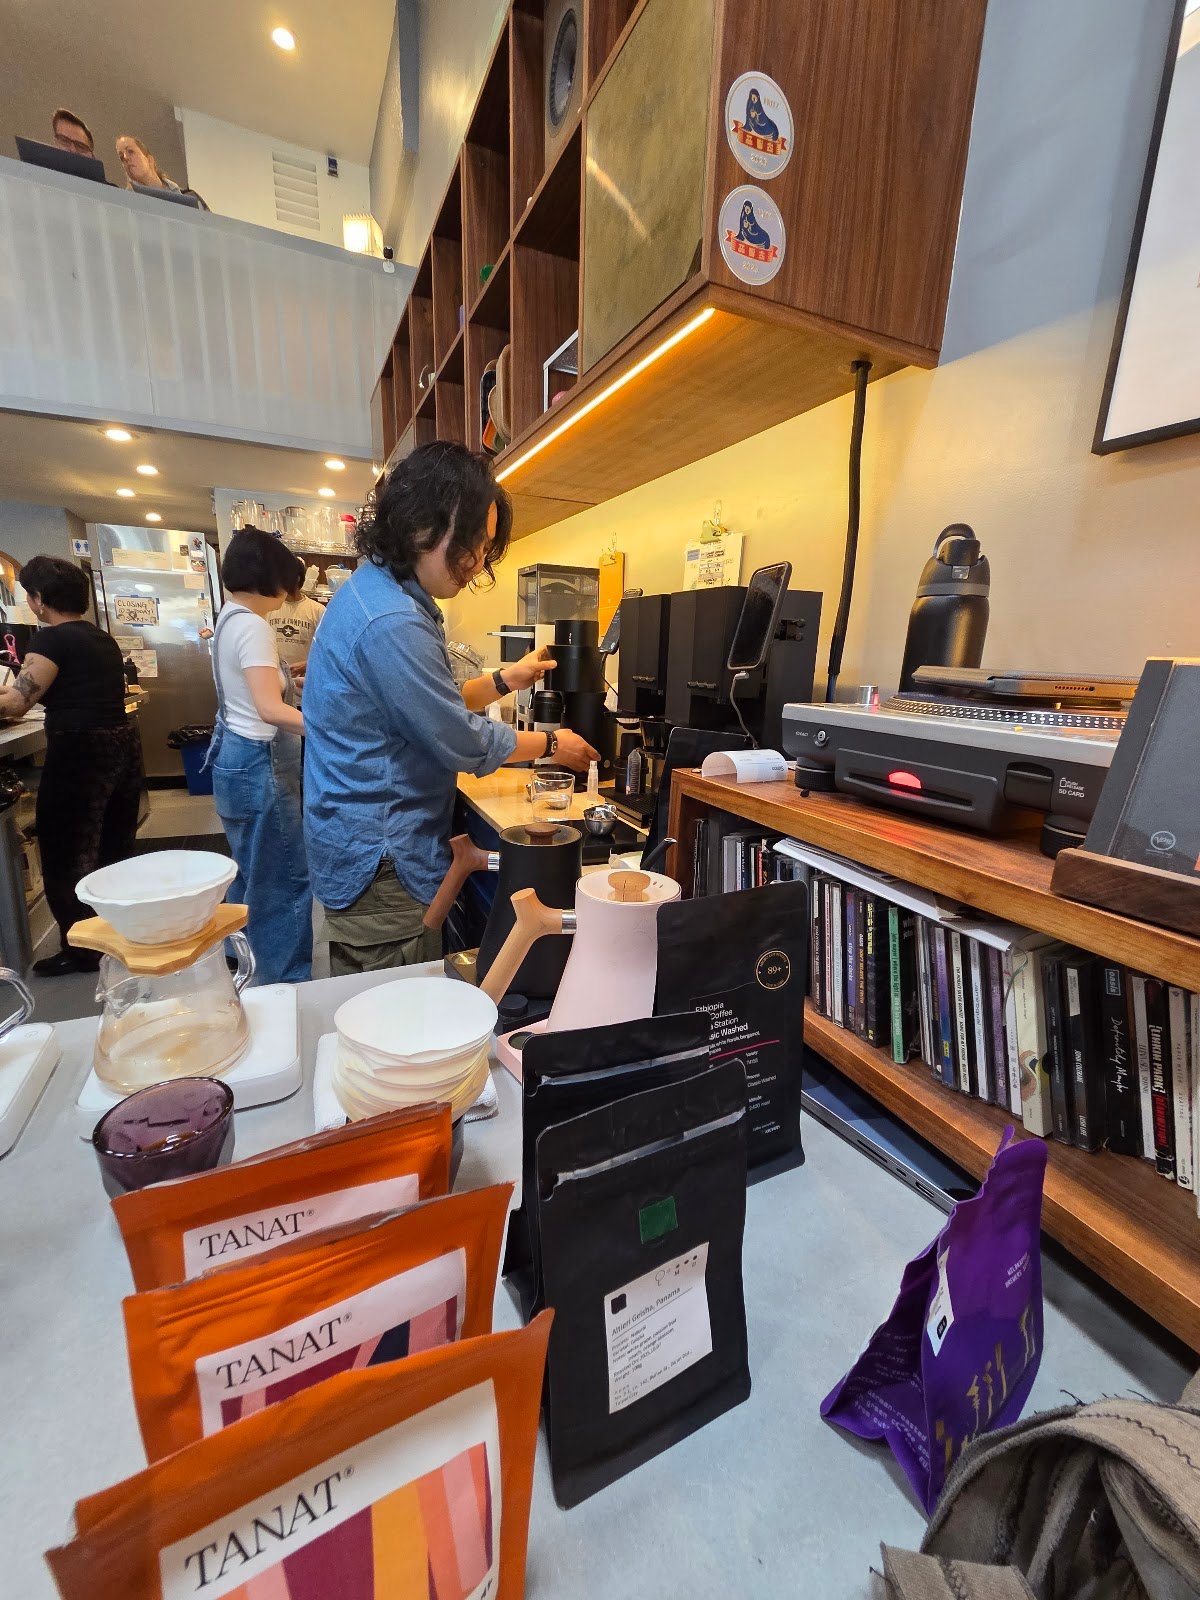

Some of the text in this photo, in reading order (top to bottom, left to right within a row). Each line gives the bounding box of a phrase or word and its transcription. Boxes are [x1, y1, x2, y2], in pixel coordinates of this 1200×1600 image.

[117, 600, 147, 608] CLOSING
[1068, 790, 1085, 798] CARD
[767, 966, 782, 975] 89+
[695, 1002, 724, 1013] Ethiopia
[714, 1016, 739, 1029] Station
[720, 1022, 749, 1037] Washed
[1107, 971, 1128, 1092] oasis Definitely Maybe
[1148, 1024, 1164, 1061] [LINKIN
[1150, 1062, 1165, 1093] PARK]
[1075, 1062, 1083, 1083] COLTRANE
[1079, 1115, 1087, 1126] LUSH
[656, 1288, 681, 1306] Panama
